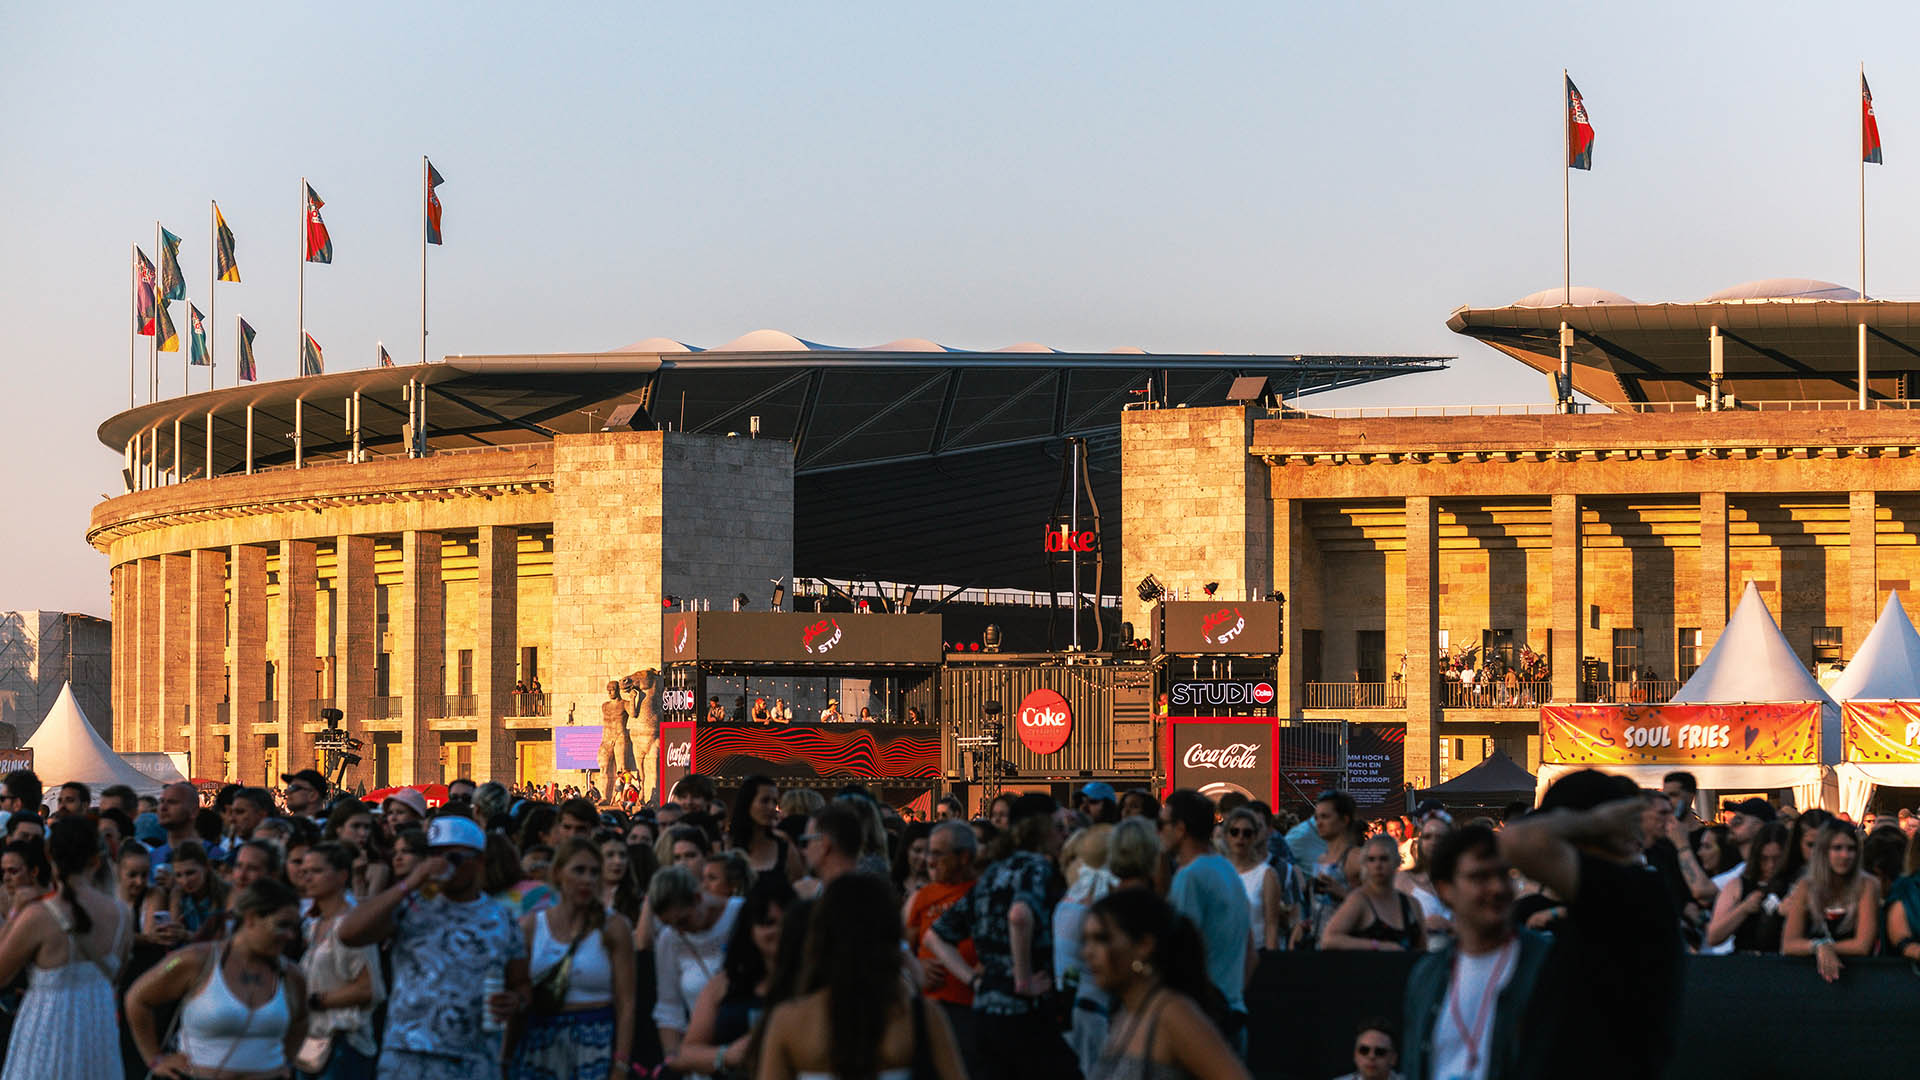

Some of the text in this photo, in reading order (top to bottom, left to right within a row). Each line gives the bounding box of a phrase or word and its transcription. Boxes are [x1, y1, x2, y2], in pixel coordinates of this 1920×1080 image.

[1044, 524, 1096, 552] oke
[1022, 707, 1066, 727] Coke
[1623, 724, 1730, 749] SOUL FRIES
[0, 759, 30, 773] RINKS
